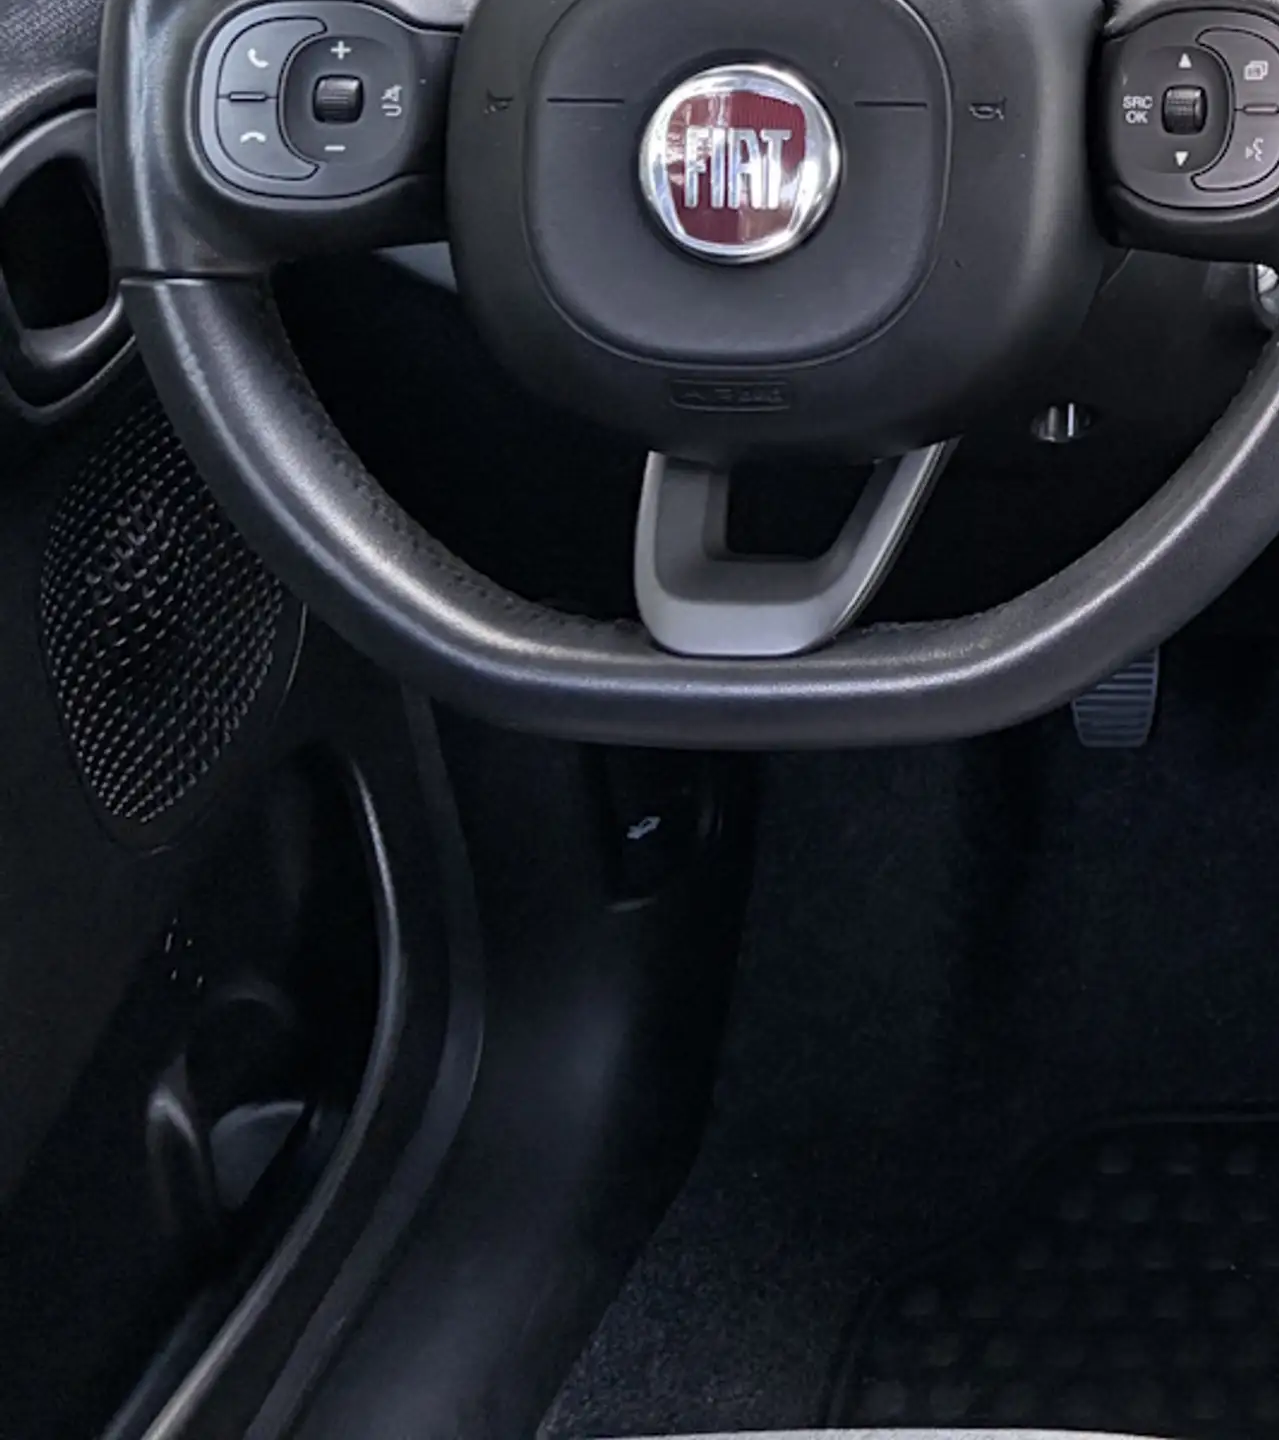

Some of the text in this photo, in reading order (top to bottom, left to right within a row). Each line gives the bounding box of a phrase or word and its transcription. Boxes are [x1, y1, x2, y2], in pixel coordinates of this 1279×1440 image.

[1123, 95, 1152, 109] SRC
[1125, 111, 1148, 124] OK
[684, 126, 793, 210] FIAT
